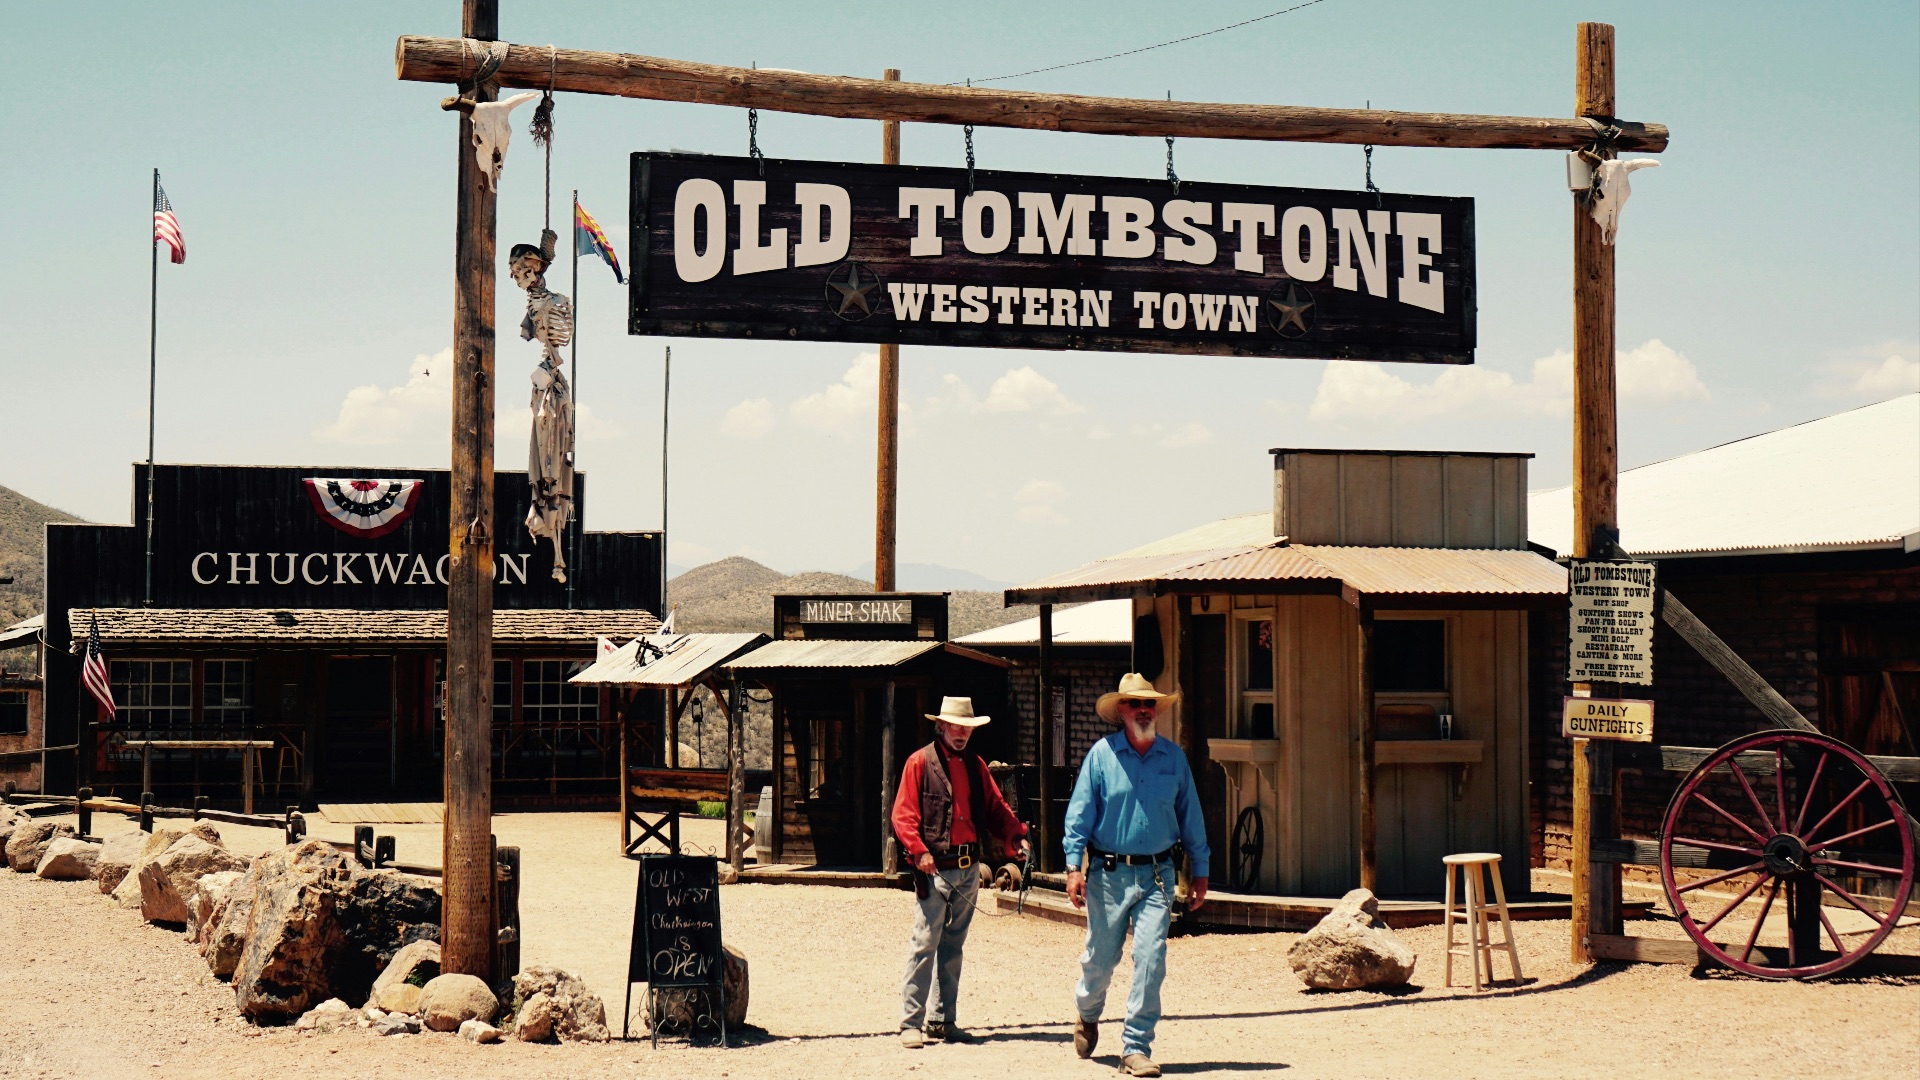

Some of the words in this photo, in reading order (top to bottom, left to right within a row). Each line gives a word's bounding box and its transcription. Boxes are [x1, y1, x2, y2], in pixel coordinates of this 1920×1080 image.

[673, 178, 852, 283] OLD
[898, 185, 1446, 314] TOMBSTONE
[886, 282, 1113, 329] WESTERN
[1134, 291, 1260, 333] TOWN
[191, 552, 531, 585] CHUCKWAN
[1573, 566, 1591, 585] OLD
[1594, 566, 1651, 587] TOMBSTONE
[1574, 585, 1619, 597] WESTERN
[1623, 587, 1650, 598] TOWN
[806, 602, 853, 622] MINER
[859, 602, 903, 622] SHAK
[1579, 609, 1614, 617] GUNFIGHT
[1611, 627, 1644, 635] GALLERY
[1577, 651, 1609, 659] CANTINA
[1586, 643, 1634, 651] RESTAURANT
[1587, 704, 1629, 717] DAILY
[1570, 718, 1644, 734] GUNFIGHTS
[650, 869, 685, 887] OLD
[666, 888, 712, 907] WEST
[653, 947, 714, 980] OPEN
